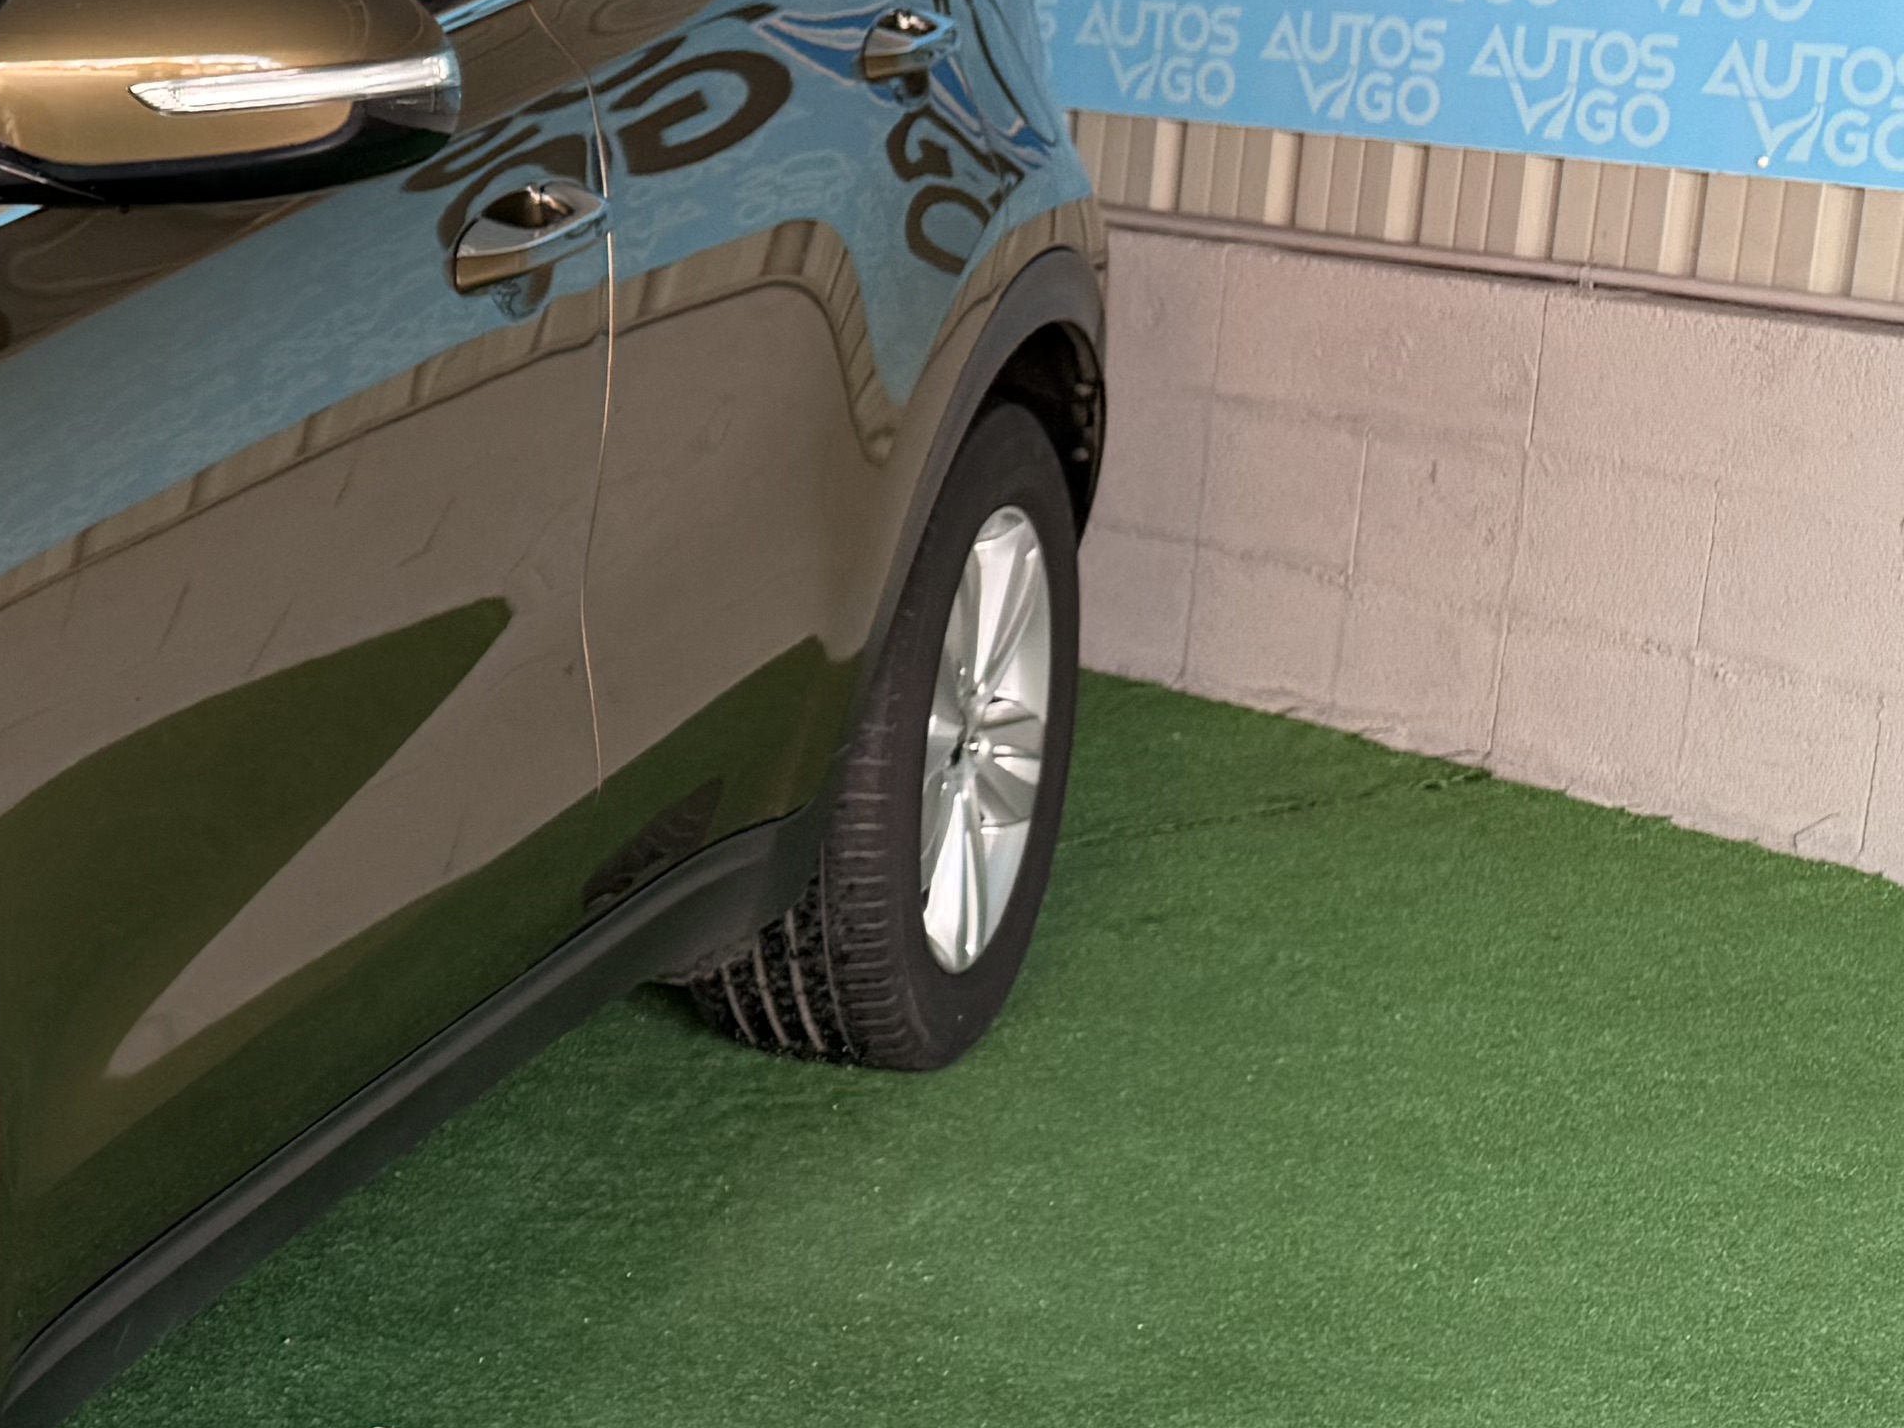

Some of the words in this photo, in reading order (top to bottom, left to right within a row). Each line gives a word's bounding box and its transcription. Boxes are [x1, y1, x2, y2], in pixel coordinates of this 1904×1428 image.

[1261, 10, 1448, 72] AUTOS
[1470, 23, 1678, 91] AUTOS
[1109, 49, 1236, 107] VIGO
[1297, 64, 1441, 126] VIGO
[1701, 38, 1904, 111] AUTO
[1505, 82, 1670, 148] VIGO
